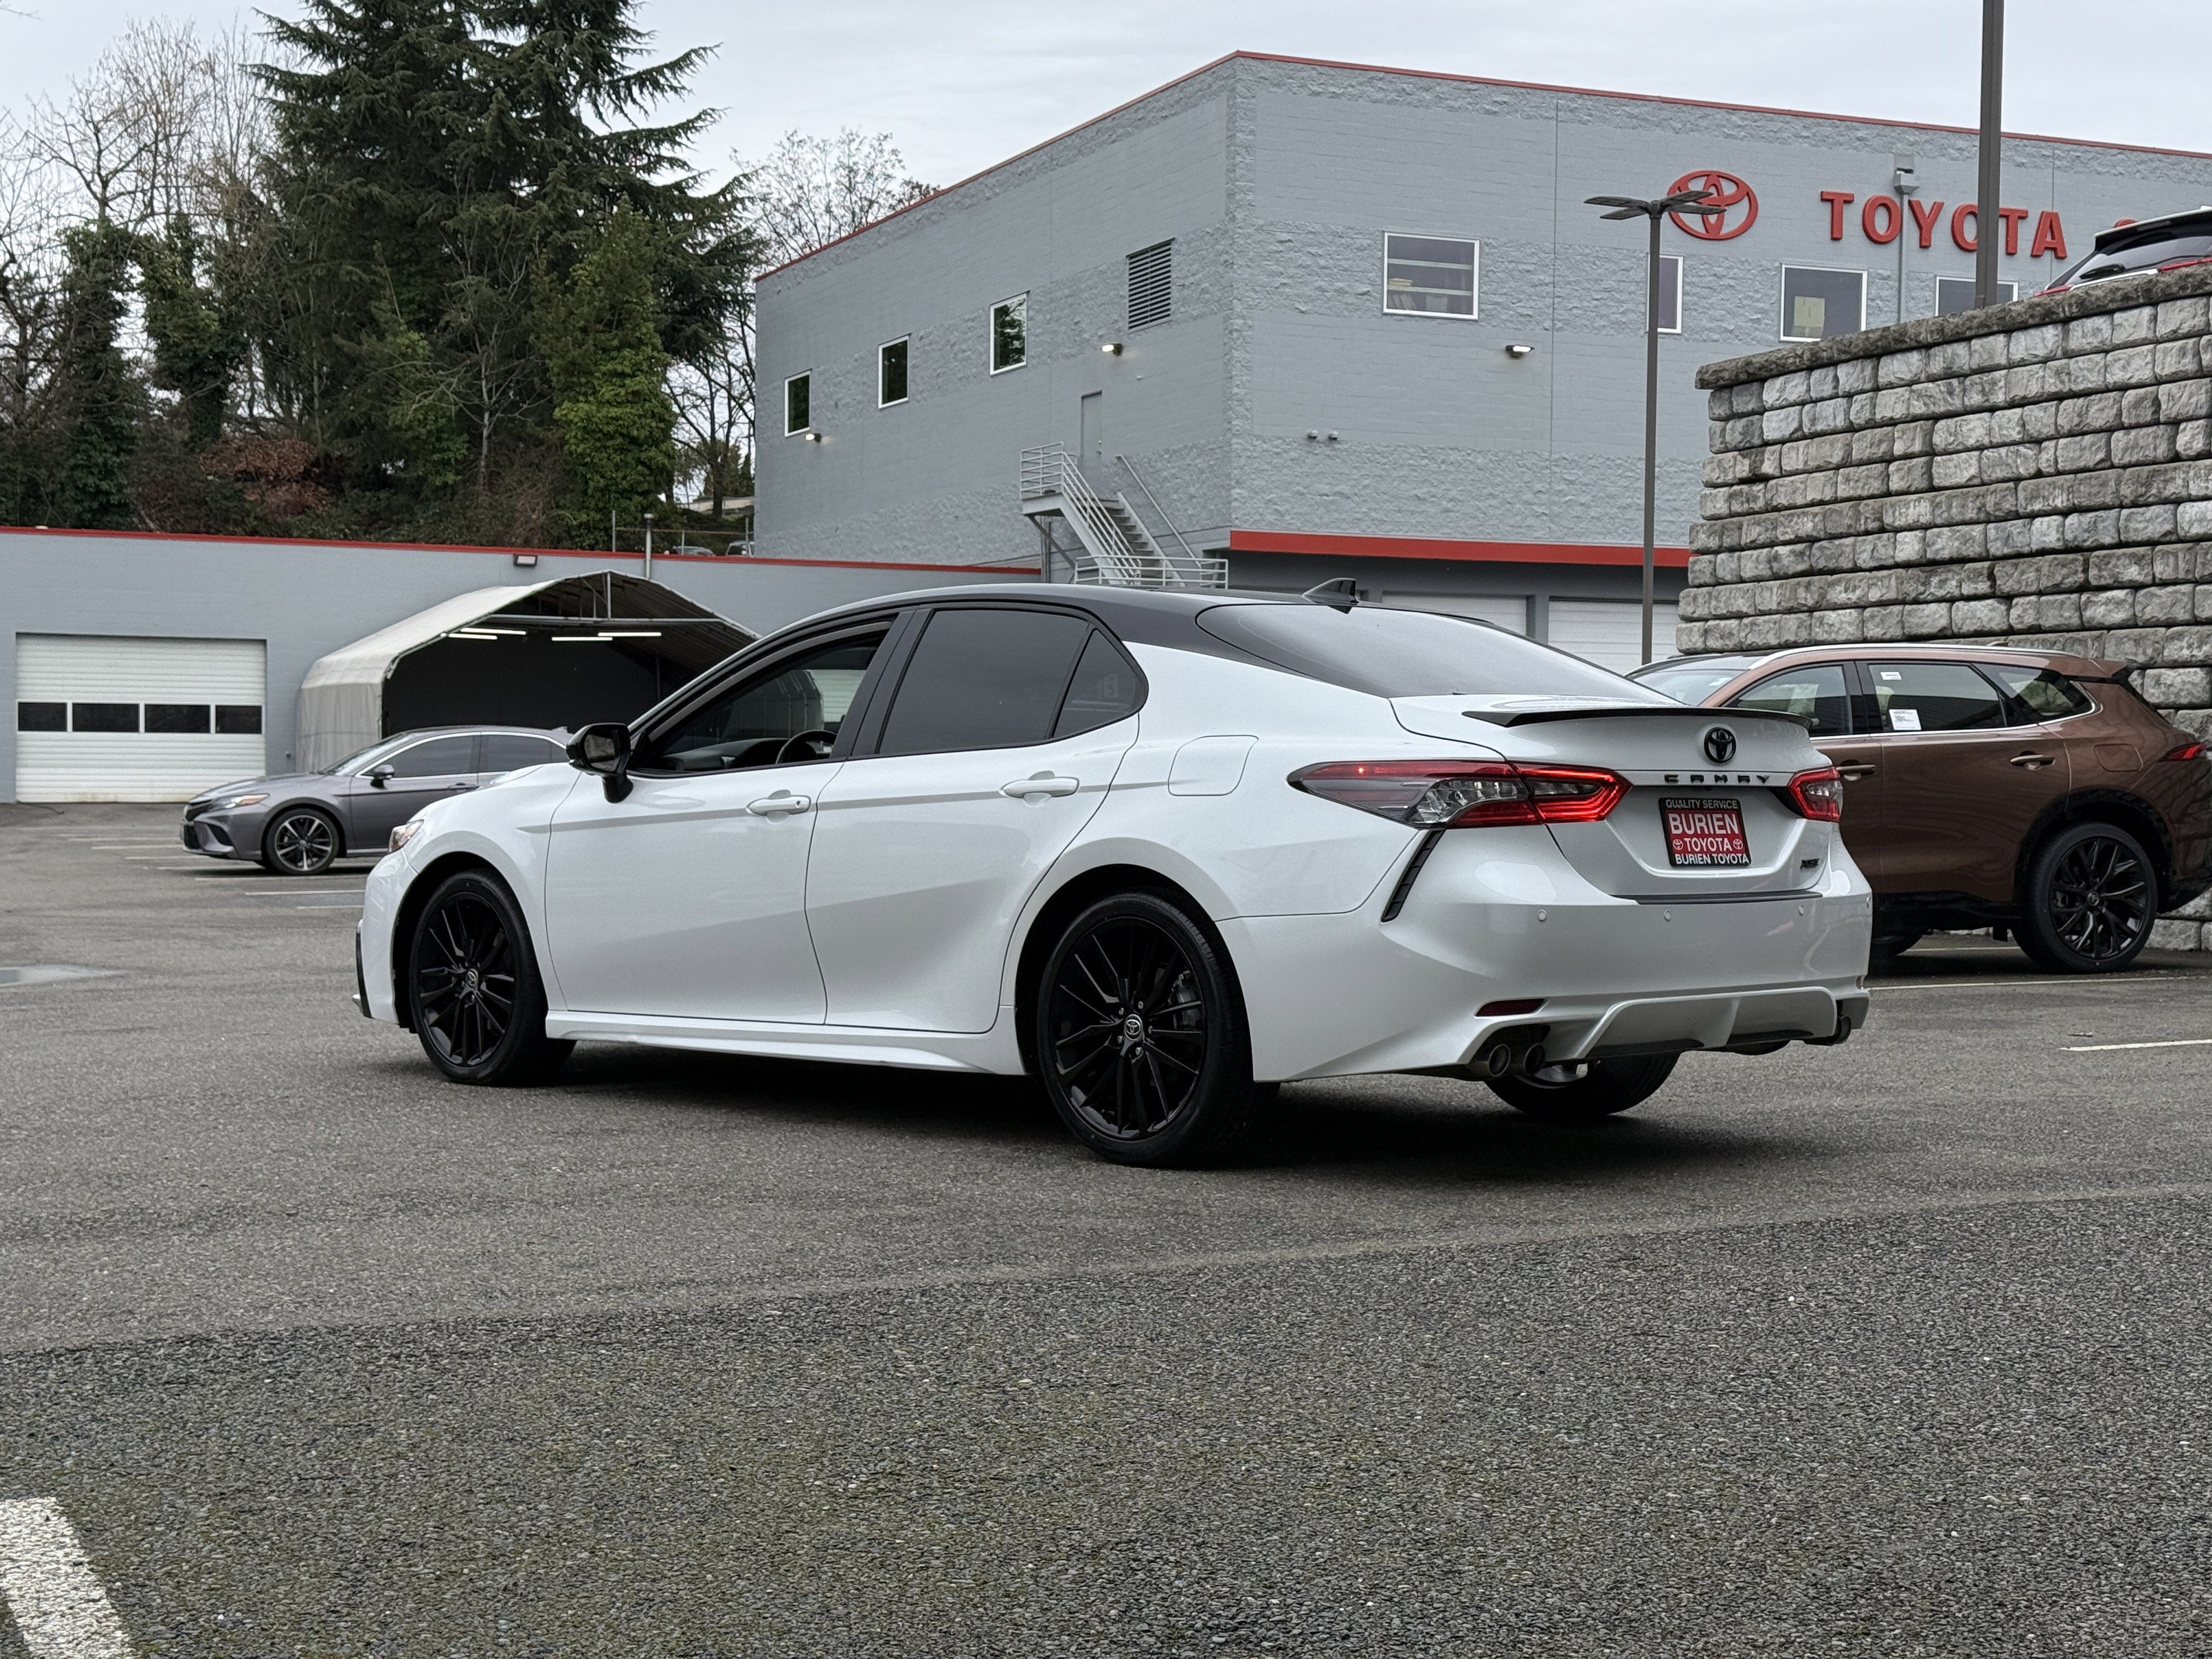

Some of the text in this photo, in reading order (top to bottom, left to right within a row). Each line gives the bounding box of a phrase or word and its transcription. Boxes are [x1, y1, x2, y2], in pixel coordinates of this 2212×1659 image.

[1820, 190, 2067, 259] TOYOTA
[1664, 774, 1771, 785] CAMRY
[1666, 799, 1739, 809] QUALITY SERVICE
[1668, 813, 1740, 835] BURIEN
[1684, 837, 1733, 852] TOYOTA
[1675, 853, 1750, 865] BURIEN TOYOTA
